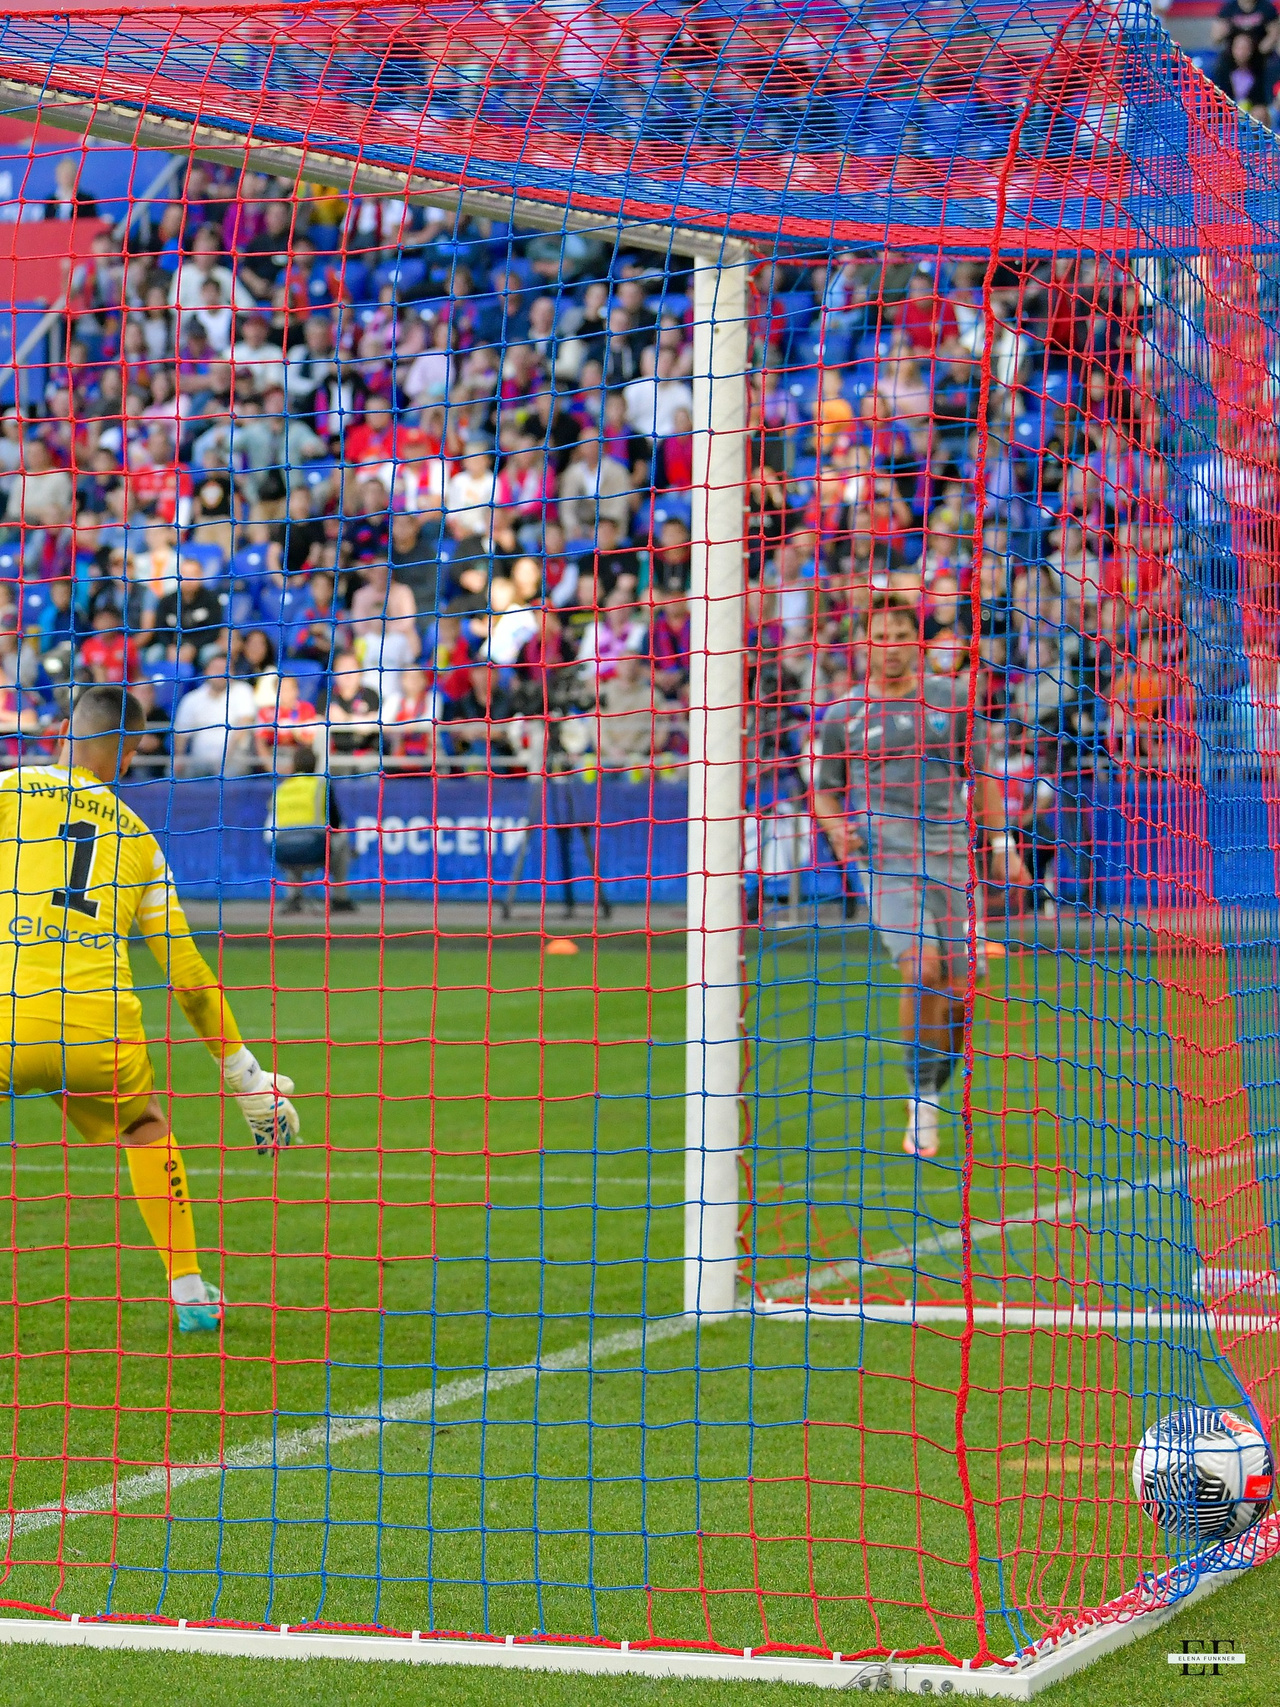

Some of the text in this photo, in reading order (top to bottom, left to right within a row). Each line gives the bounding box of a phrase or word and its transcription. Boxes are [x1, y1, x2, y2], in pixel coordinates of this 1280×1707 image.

[28, 781, 141, 836] ЛУКЬЯНОВ
[355, 815, 528, 856] РОССЕТИ
[50, 820, 99, 919] 1
